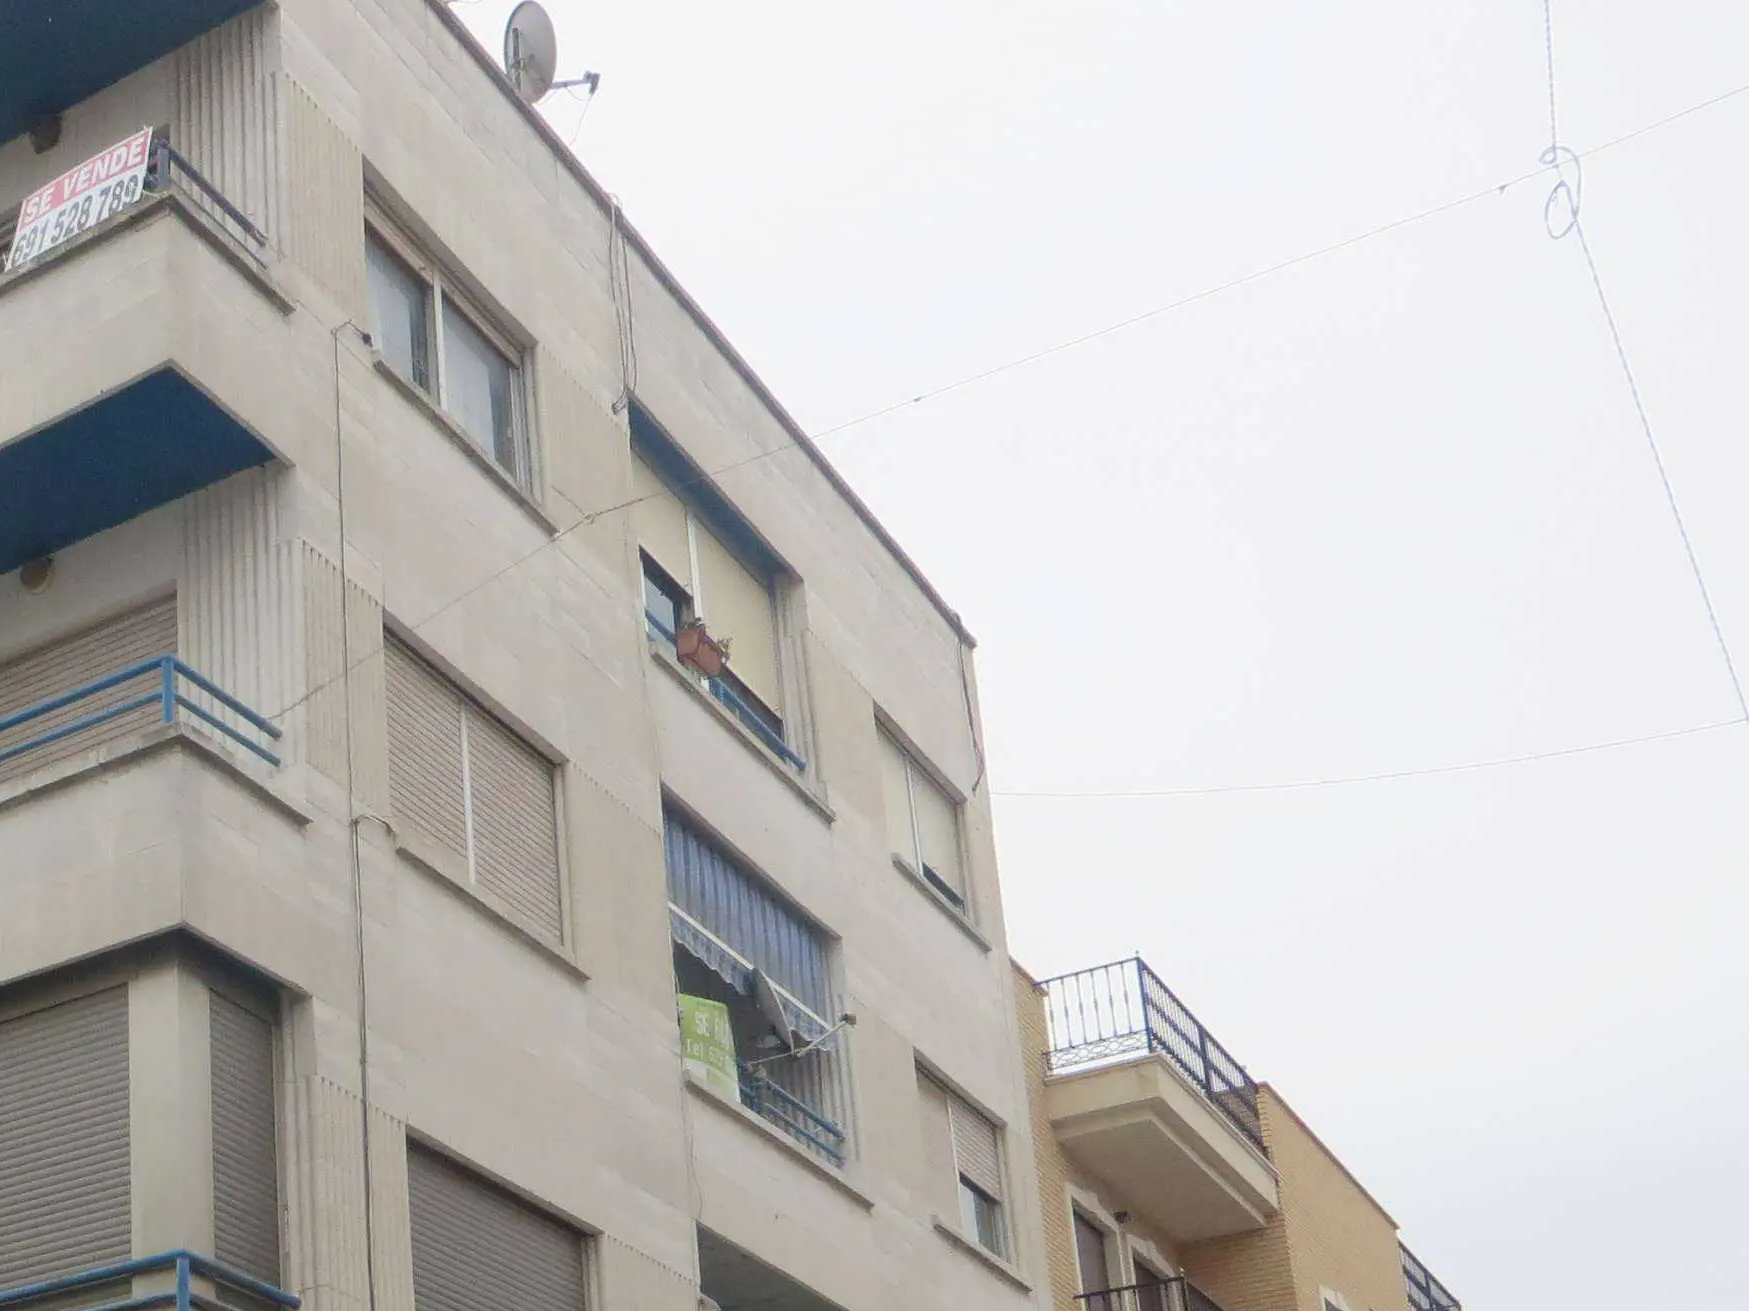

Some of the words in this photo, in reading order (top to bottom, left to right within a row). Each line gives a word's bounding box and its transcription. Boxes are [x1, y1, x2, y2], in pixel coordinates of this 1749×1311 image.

[11, 218, 48, 267] 691
[52, 195, 93, 243] 528
[96, 174, 139, 223] 789
[23, 186, 56, 222] SE
[62, 136, 145, 201] VENDE
[694, 1011, 710, 1037] SE
